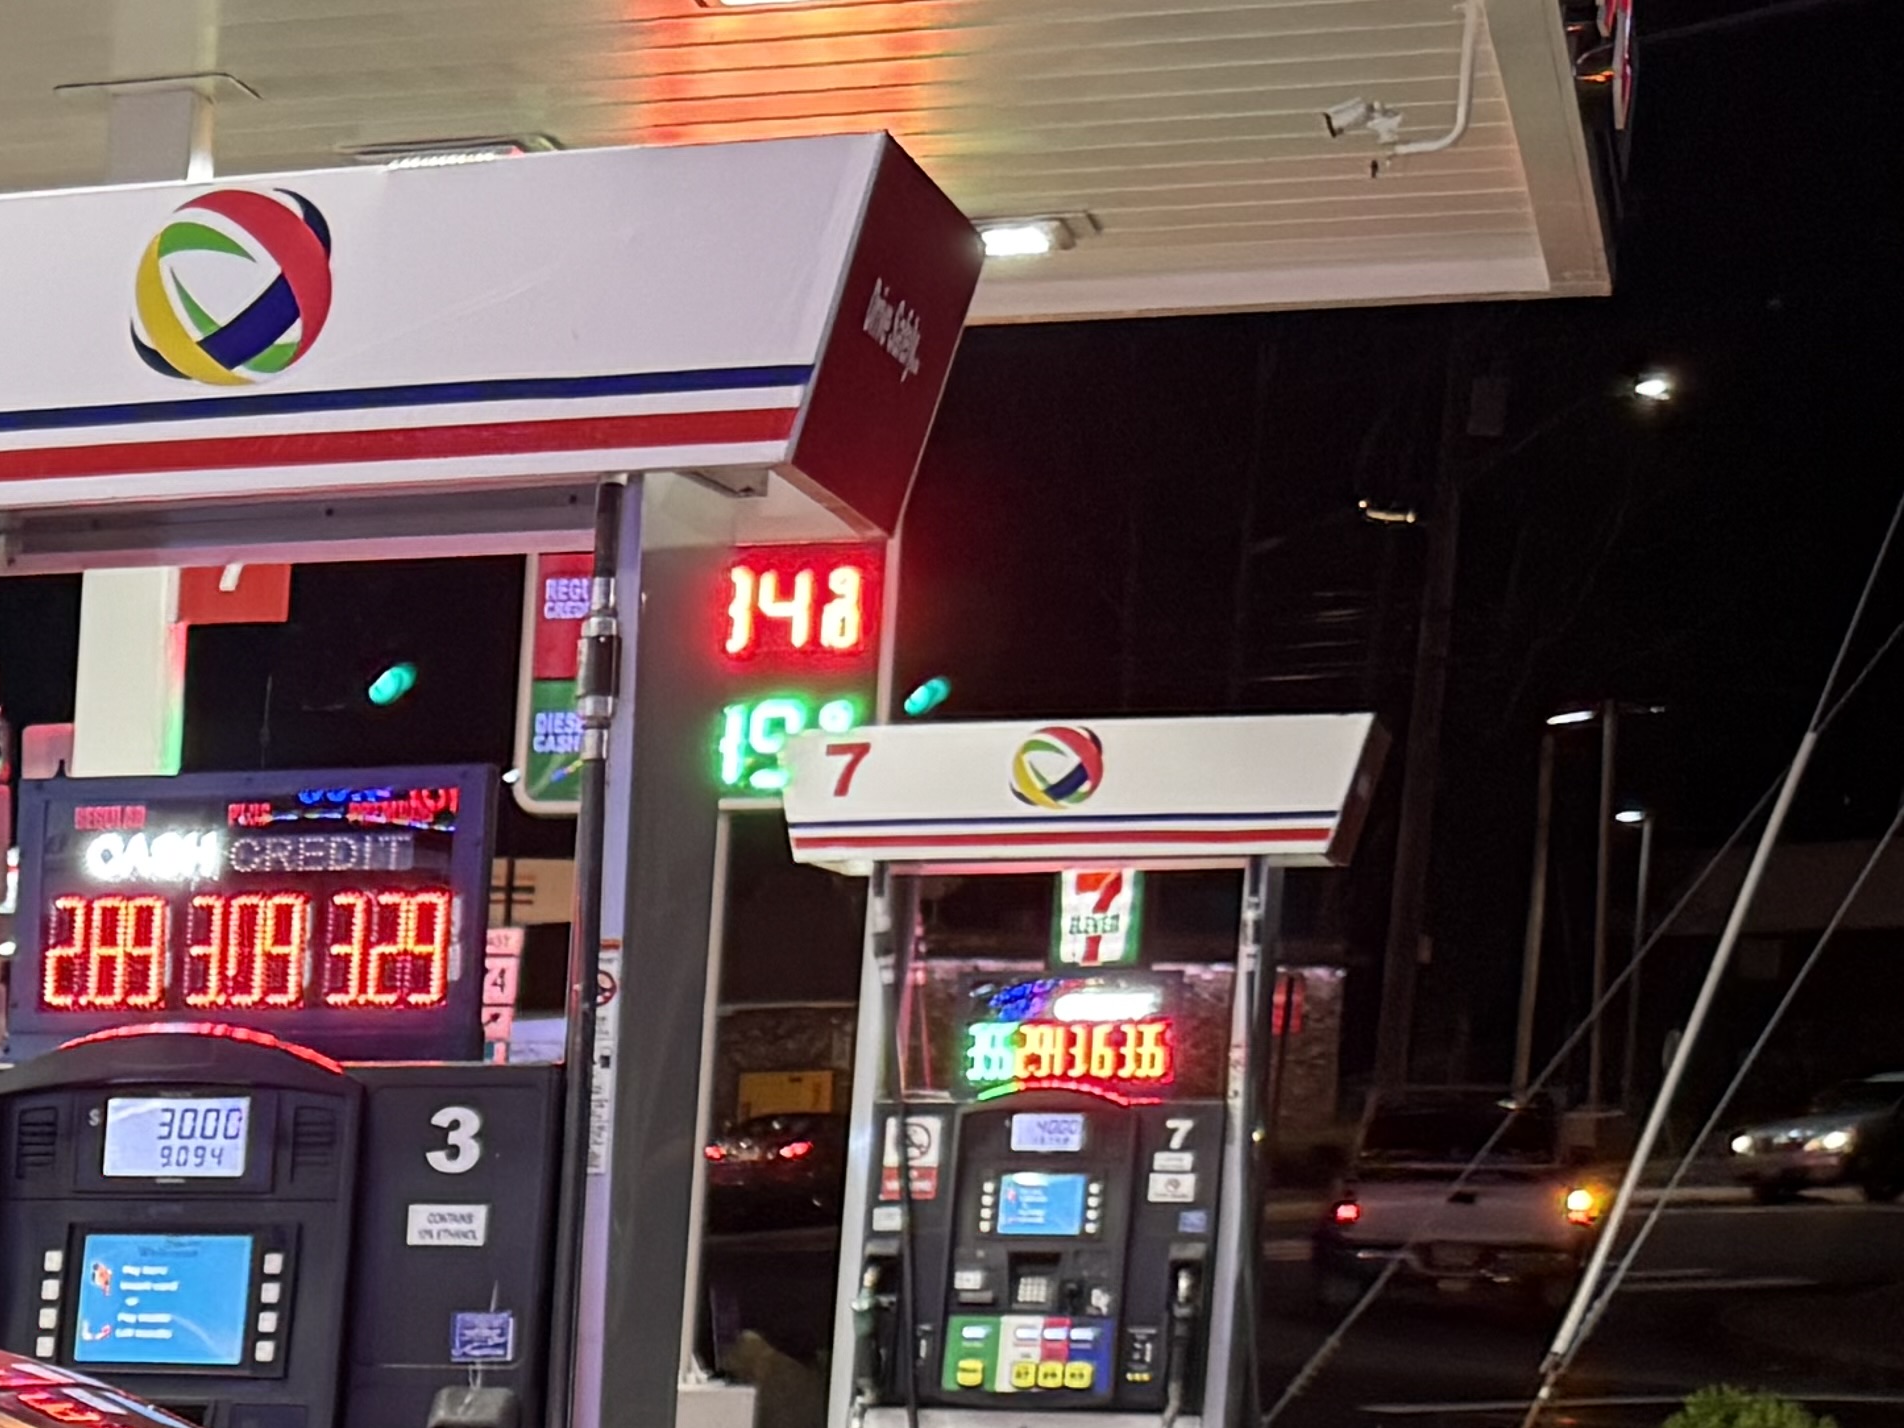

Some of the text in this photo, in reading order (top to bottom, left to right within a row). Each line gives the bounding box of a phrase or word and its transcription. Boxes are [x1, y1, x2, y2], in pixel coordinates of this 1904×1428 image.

[826, 742, 872, 797] 7
[229, 835, 413, 873] CREDIT
[425, 1106, 482, 1174] 3
[1165, 1118, 1194, 1150] 7
